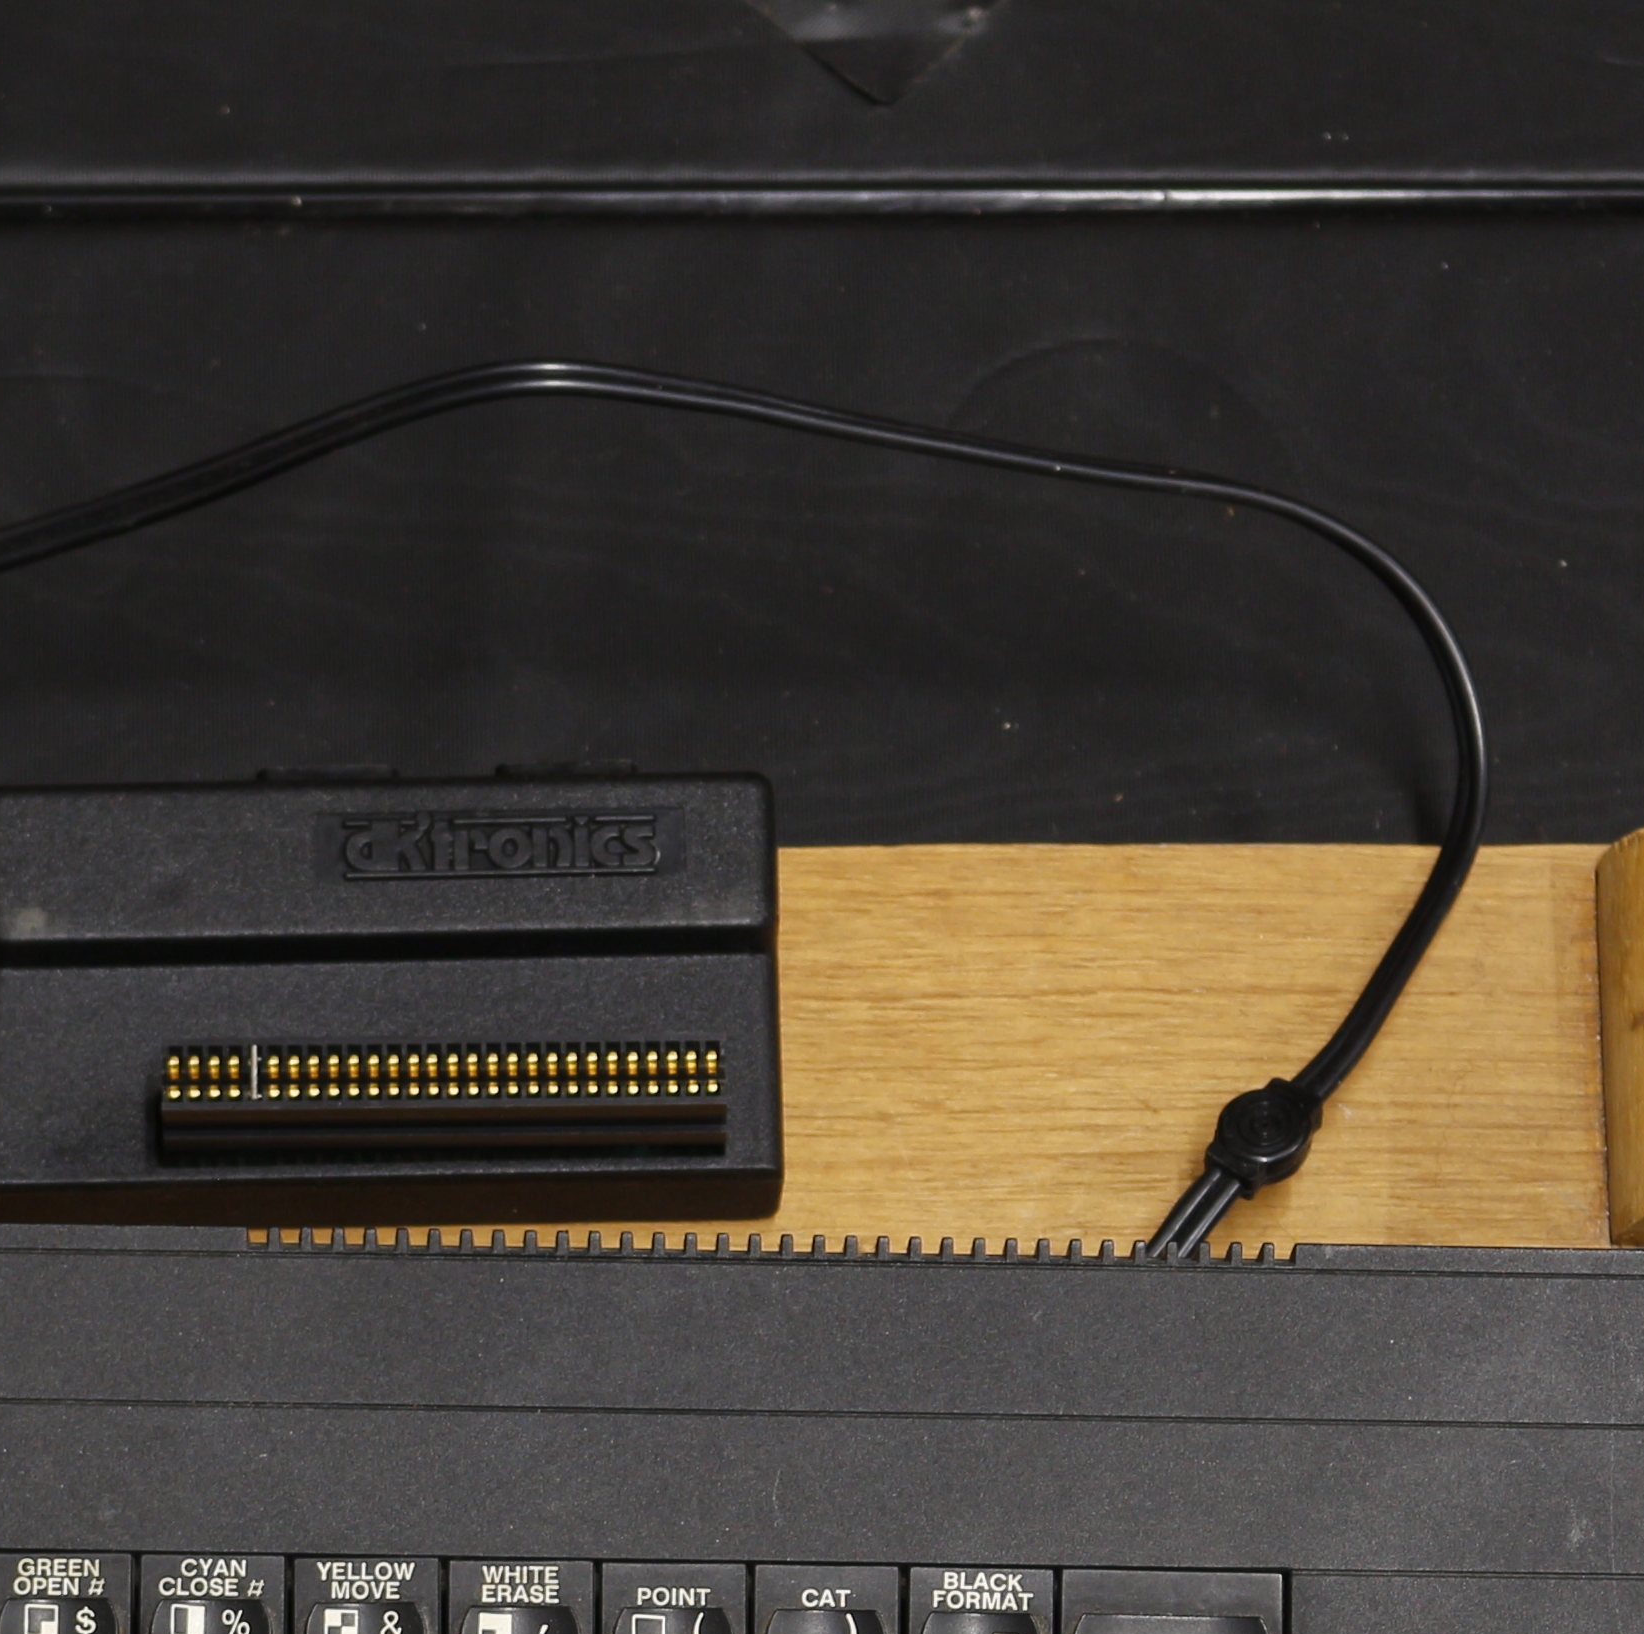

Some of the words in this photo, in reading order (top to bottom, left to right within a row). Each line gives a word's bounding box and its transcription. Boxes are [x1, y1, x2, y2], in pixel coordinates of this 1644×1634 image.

[17, 1557, 100, 1577] GREEN
[180, 1558, 247, 1577] CYAN
[316, 1561, 415, 1581] YELLOW
[482, 1565, 559, 1585] WHITE
[942, 1572, 1024, 1592] BLACK
[636, 1587, 711, 1606] POINT
[801, 1588, 852, 1608] CAT
